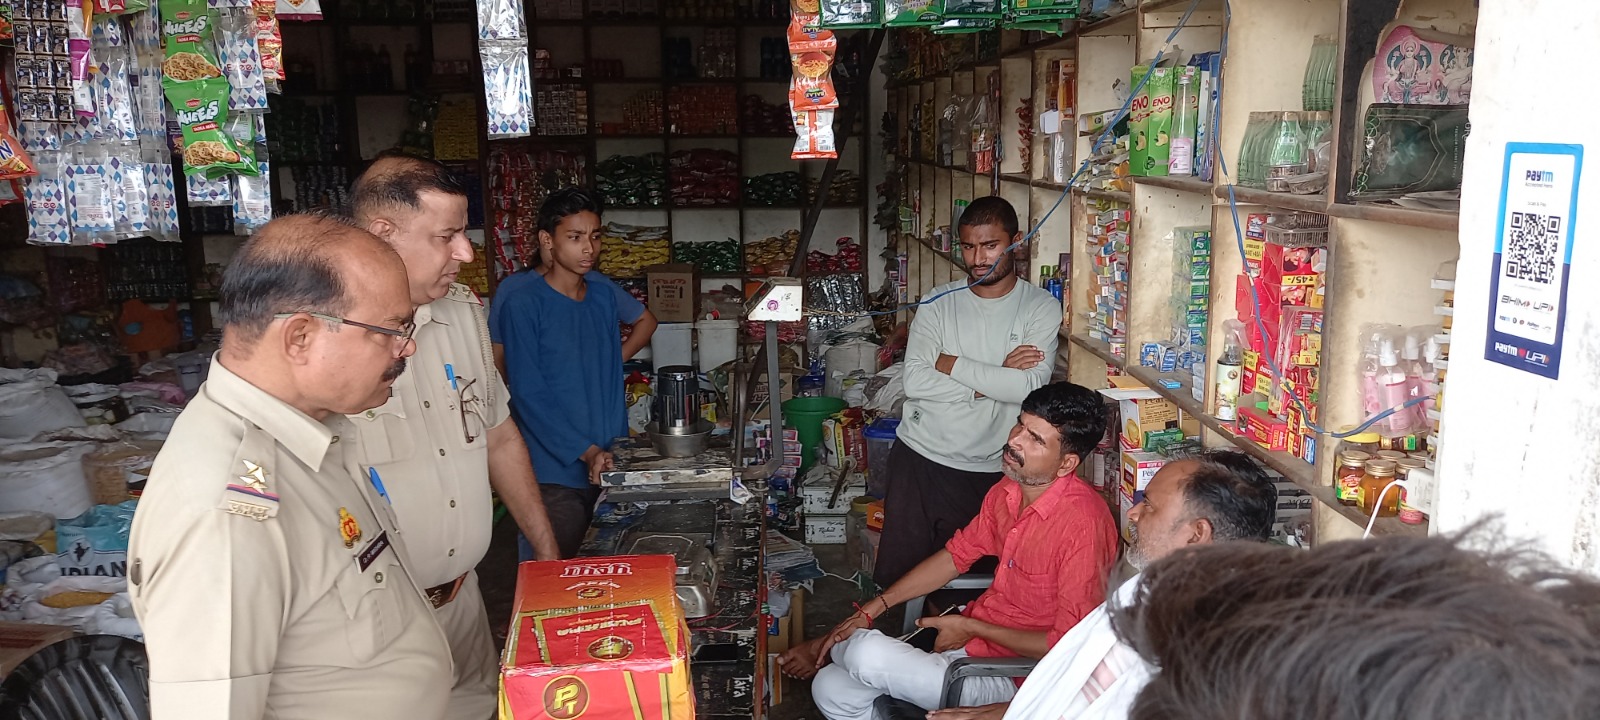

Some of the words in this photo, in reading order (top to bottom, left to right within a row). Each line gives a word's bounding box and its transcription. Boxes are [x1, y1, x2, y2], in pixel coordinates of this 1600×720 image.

[1131, 94, 1149, 113] ENO
[1152, 96, 1171, 107] ENO
[31, 200, 57, 209] Ezee
[1525, 350, 1546, 364] UPI
[732, 673, 753, 698] Tara
